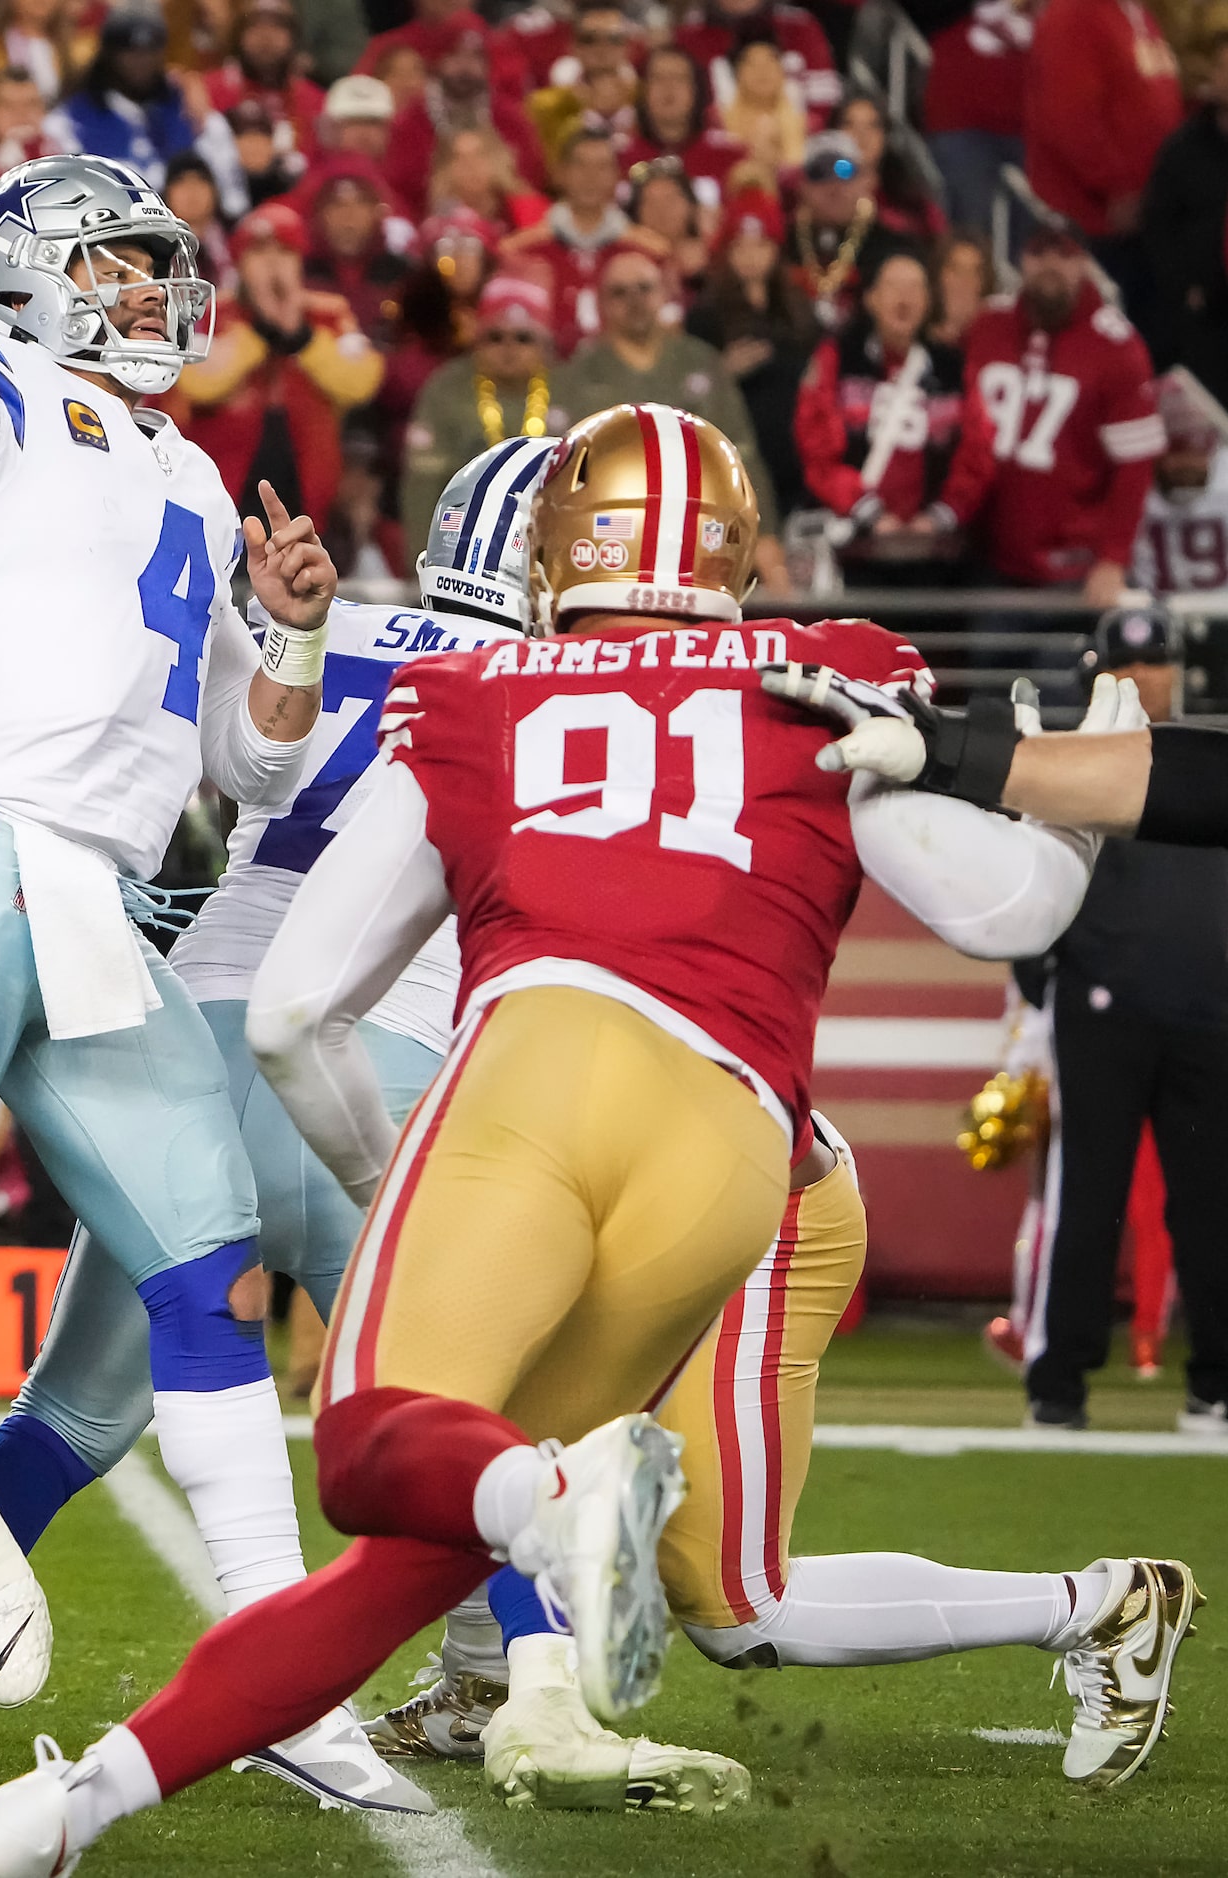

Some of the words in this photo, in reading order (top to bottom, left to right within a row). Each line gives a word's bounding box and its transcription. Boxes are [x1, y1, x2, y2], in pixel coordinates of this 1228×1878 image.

[67, 401, 104, 438] C
[978, 362, 1080, 471] 97
[574, 545, 594, 563] JM
[602, 545, 624, 565] 39
[137, 498, 216, 727] 4
[436, 575, 506, 606] COWBOYS
[480, 629, 788, 682] ARMSTEAD
[510, 687, 753, 874] 91
